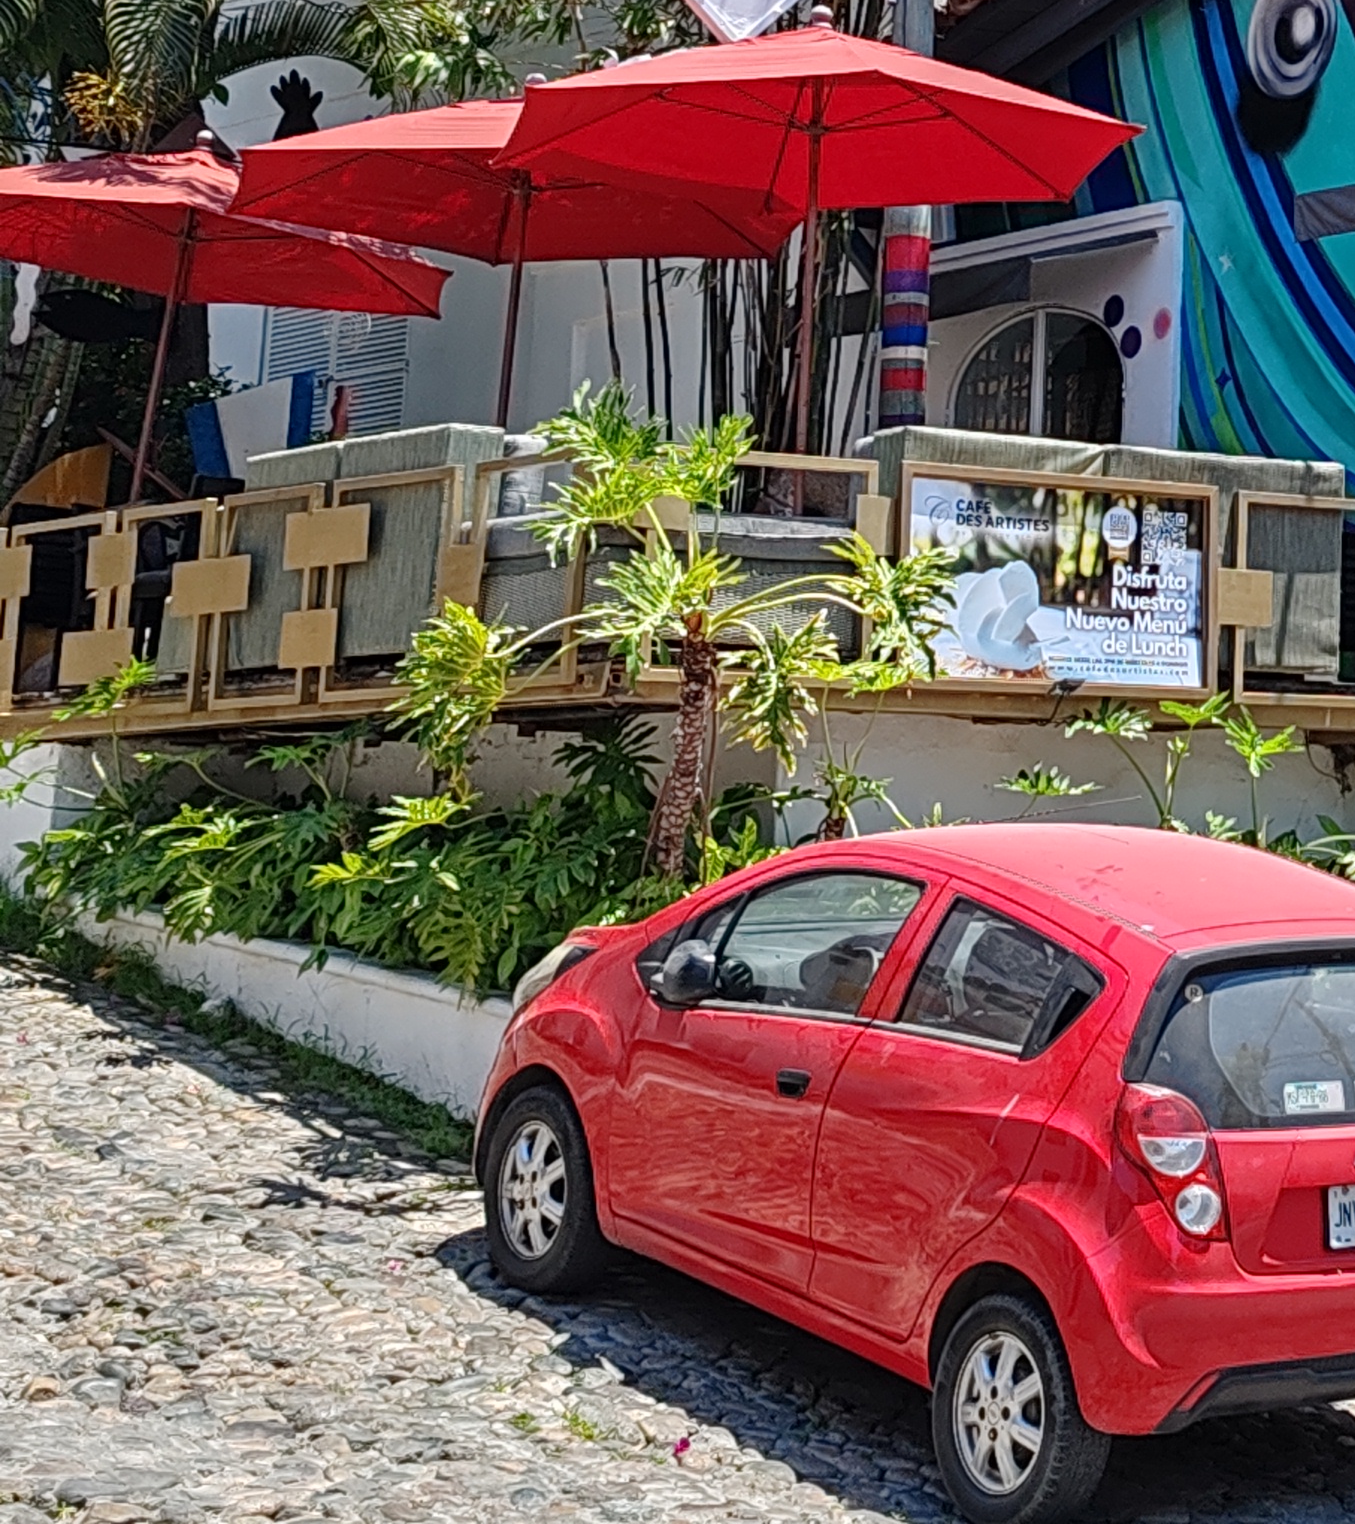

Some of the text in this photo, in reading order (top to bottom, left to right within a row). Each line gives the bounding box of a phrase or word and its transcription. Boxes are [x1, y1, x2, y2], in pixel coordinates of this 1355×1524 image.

[956, 513, 1050, 532] DES ARTISTES
[1113, 565, 1187, 591] Disfruta
[1111, 587, 1187, 613] Nuestro
[1066, 606, 1187, 634] Nuevo Menú
[1102, 632, 1187, 657] de Lunch
